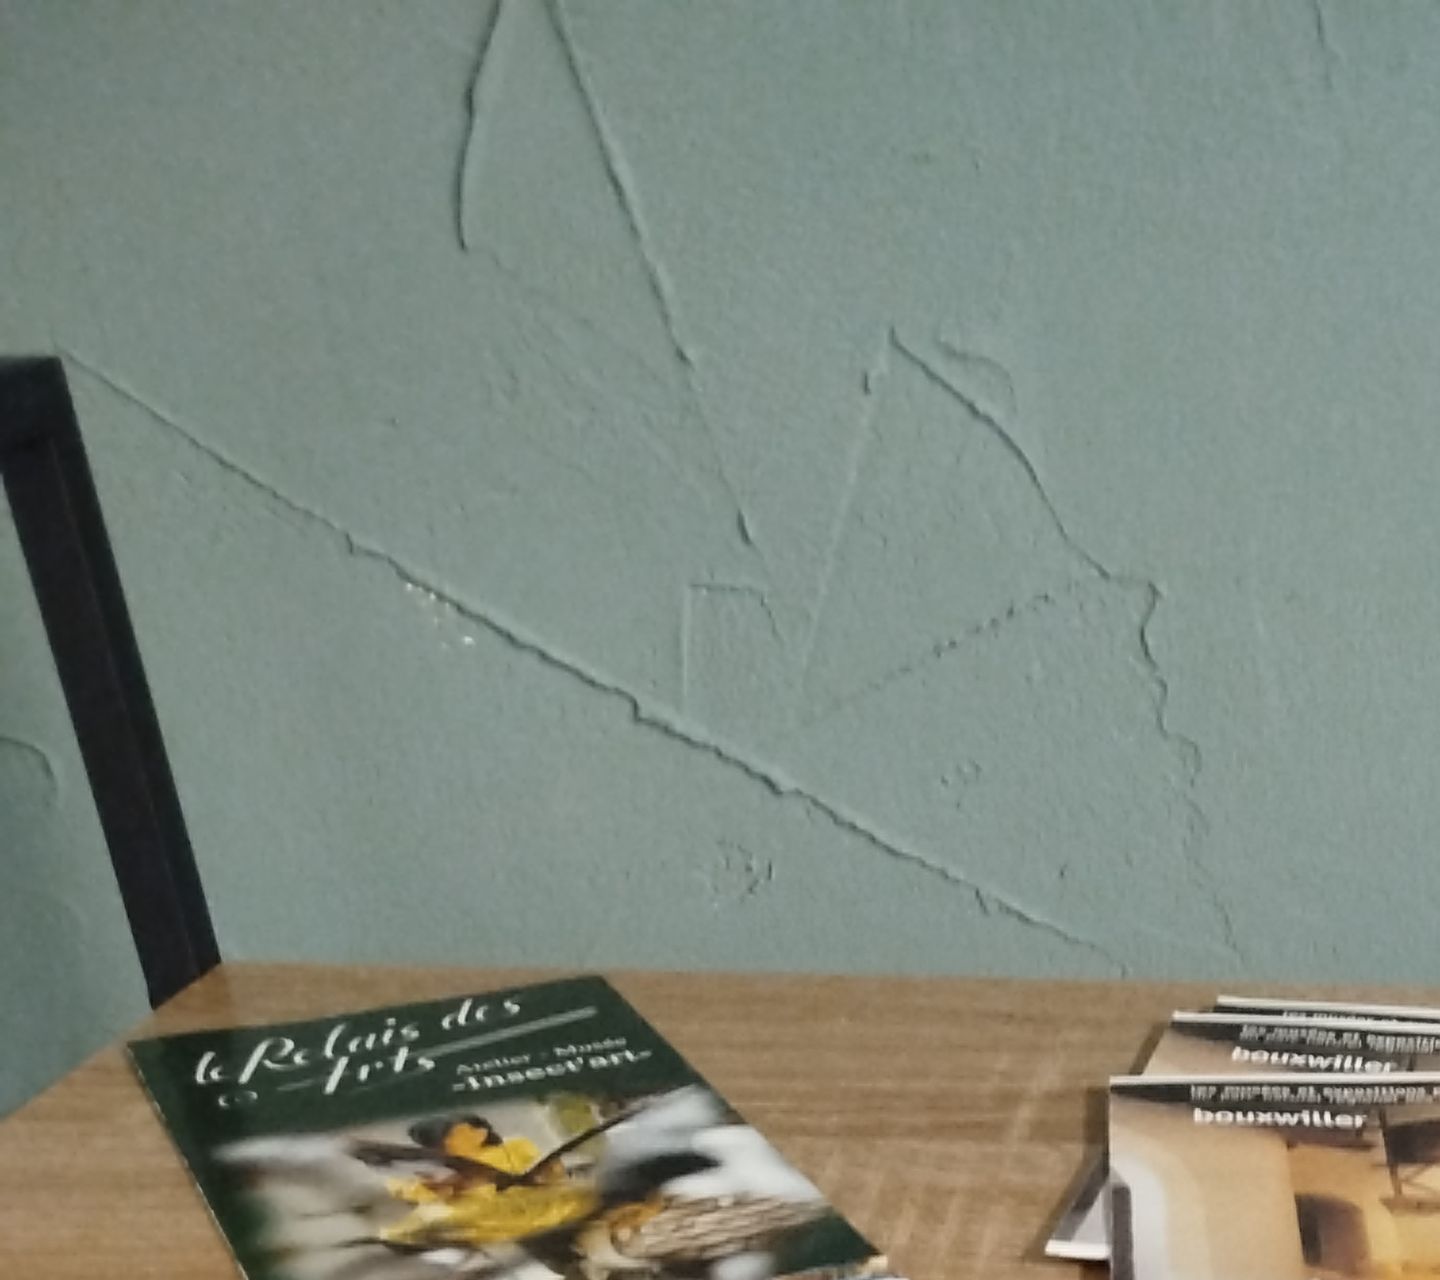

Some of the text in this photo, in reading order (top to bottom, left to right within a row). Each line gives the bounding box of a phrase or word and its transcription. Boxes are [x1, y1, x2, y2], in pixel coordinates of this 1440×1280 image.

[440, 998, 521, 1031] des
[1232, 1046, 1398, 1073] bouxwiller
[1194, 1107, 1367, 1129] bouxwiller
